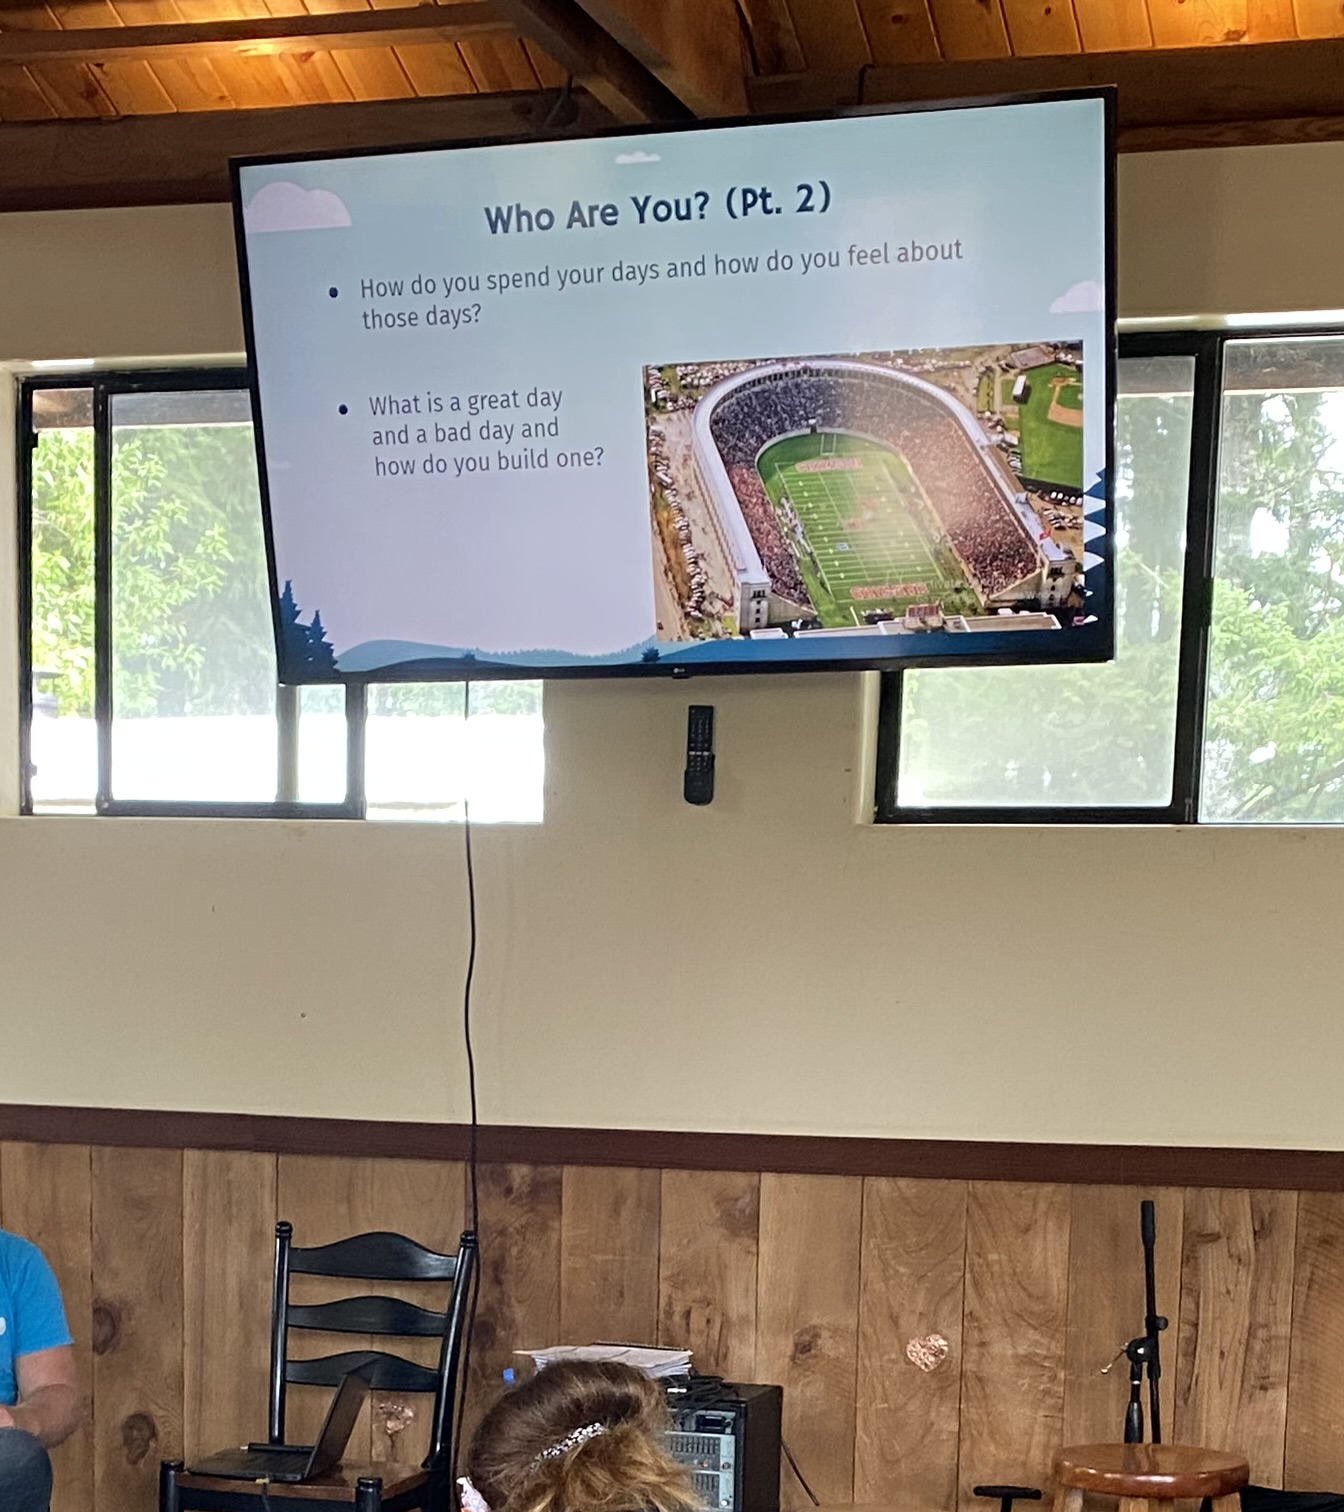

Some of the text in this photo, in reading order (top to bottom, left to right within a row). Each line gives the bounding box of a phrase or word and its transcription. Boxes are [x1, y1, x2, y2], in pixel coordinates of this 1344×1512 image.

[484, 180, 831, 235] Who Are You? (Pt. 2)
[360, 239, 963, 298] How do you spend your days and how do you feel about
[362, 303, 481, 329] those days?
[369, 387, 563, 415] What is a great day
[372, 416, 559, 445] and a bad day and
[375, 446, 604, 477] how do you build one?
